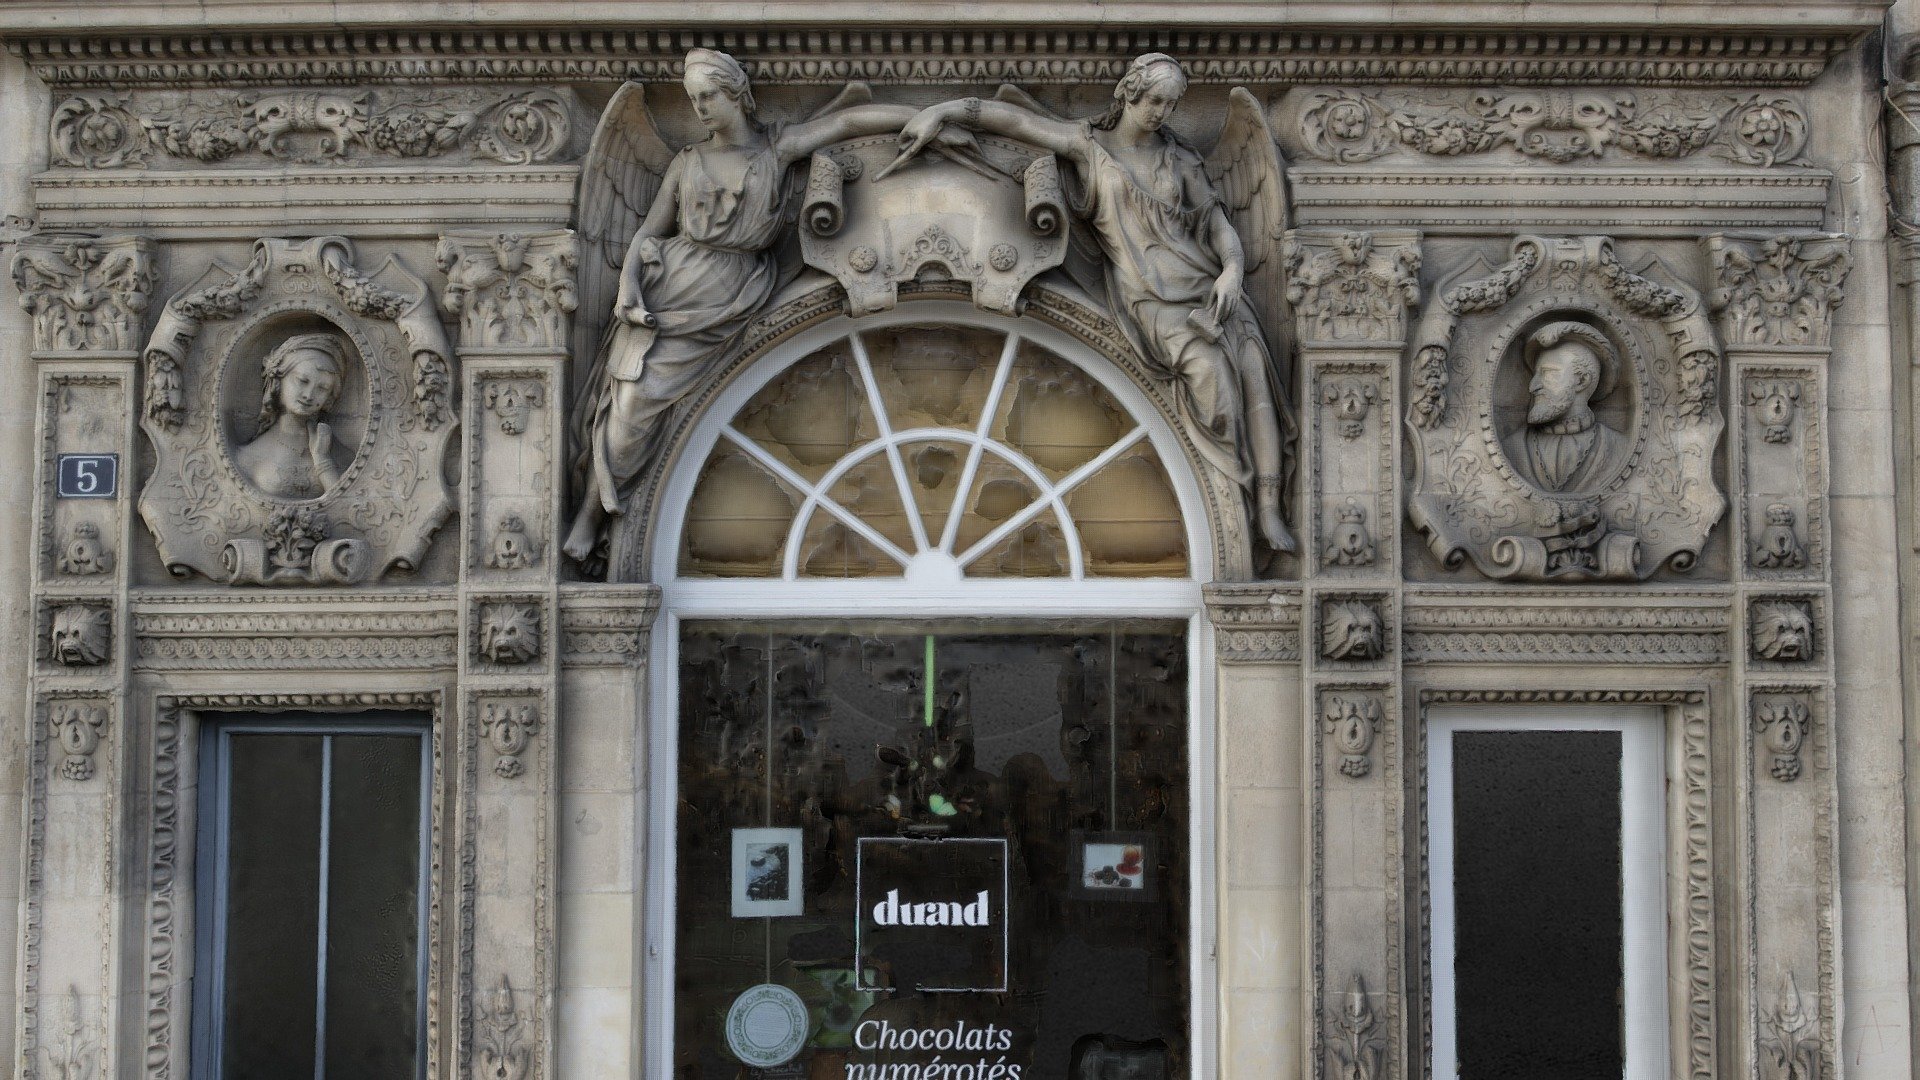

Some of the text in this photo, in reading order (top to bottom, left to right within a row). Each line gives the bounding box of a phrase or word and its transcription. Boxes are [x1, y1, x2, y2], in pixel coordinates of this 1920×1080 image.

[77, 460, 98, 492] 5
[854, 1020, 1013, 1050] Chocolats
[844, 1055, 1022, 1080] numérotés
